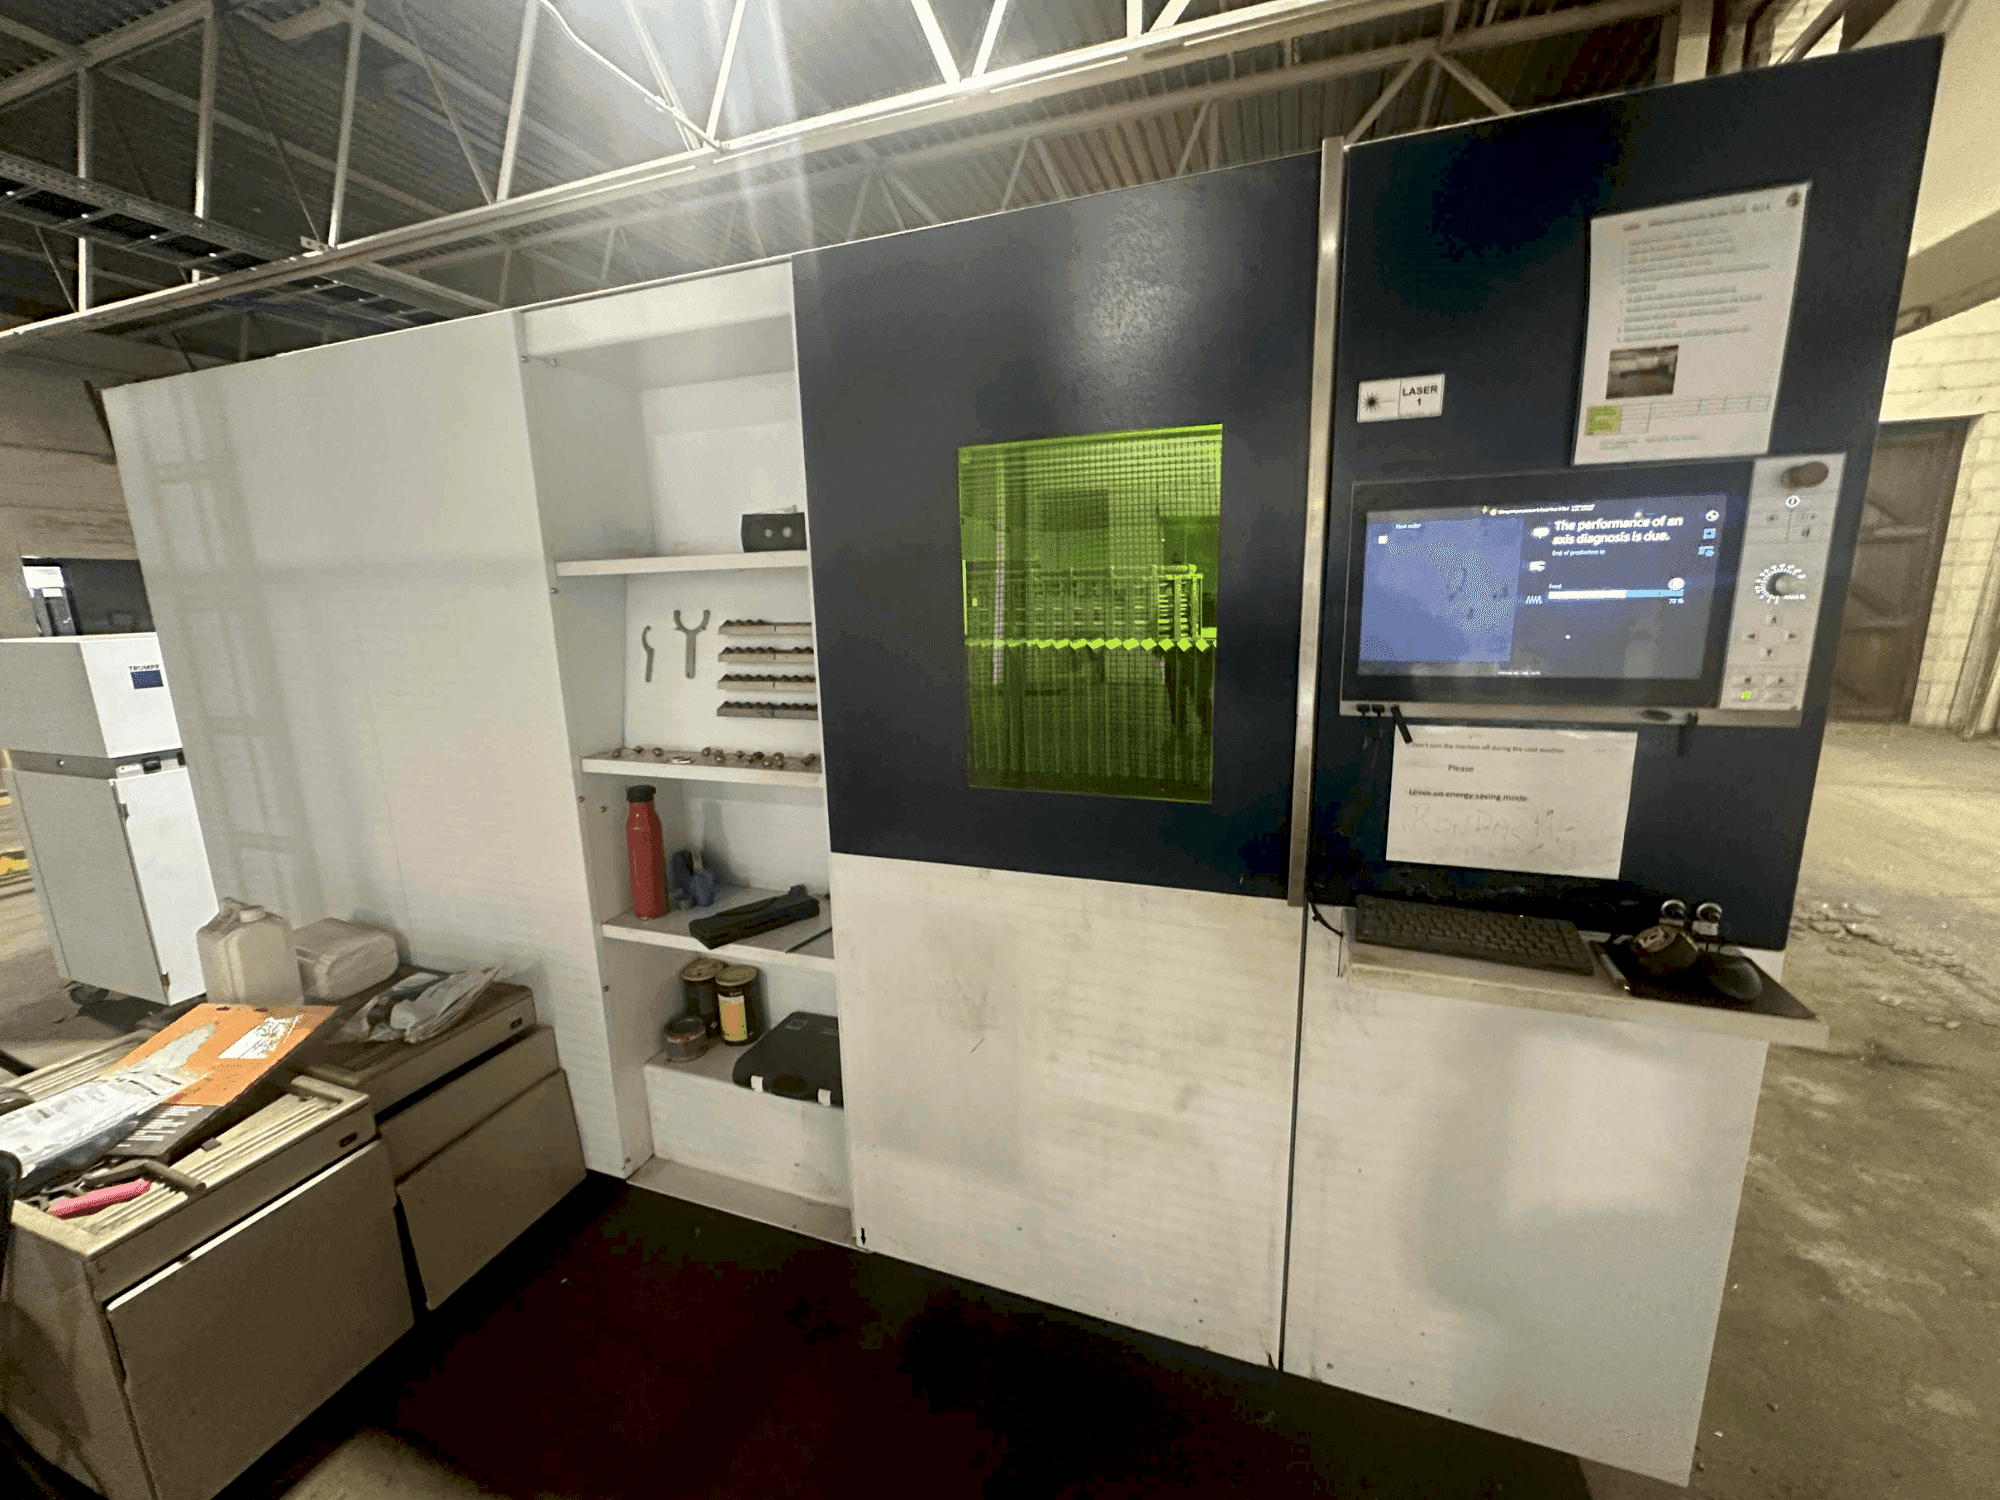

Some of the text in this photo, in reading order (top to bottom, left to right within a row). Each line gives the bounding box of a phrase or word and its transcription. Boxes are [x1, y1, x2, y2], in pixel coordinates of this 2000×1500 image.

[1402, 385, 1438, 396] LASER
[1416, 397, 1422, 406] 1
[1554, 515, 1684, 531] The performance of an
[1552, 531, 1671, 546] axis diagnosis is due.
[128, 664, 160, 672] TRUMPF
[1491, 745, 1512, 753] during
[1448, 764, 1474, 773] Please
[1409, 788, 1528, 802] Leave on energy saving mode
